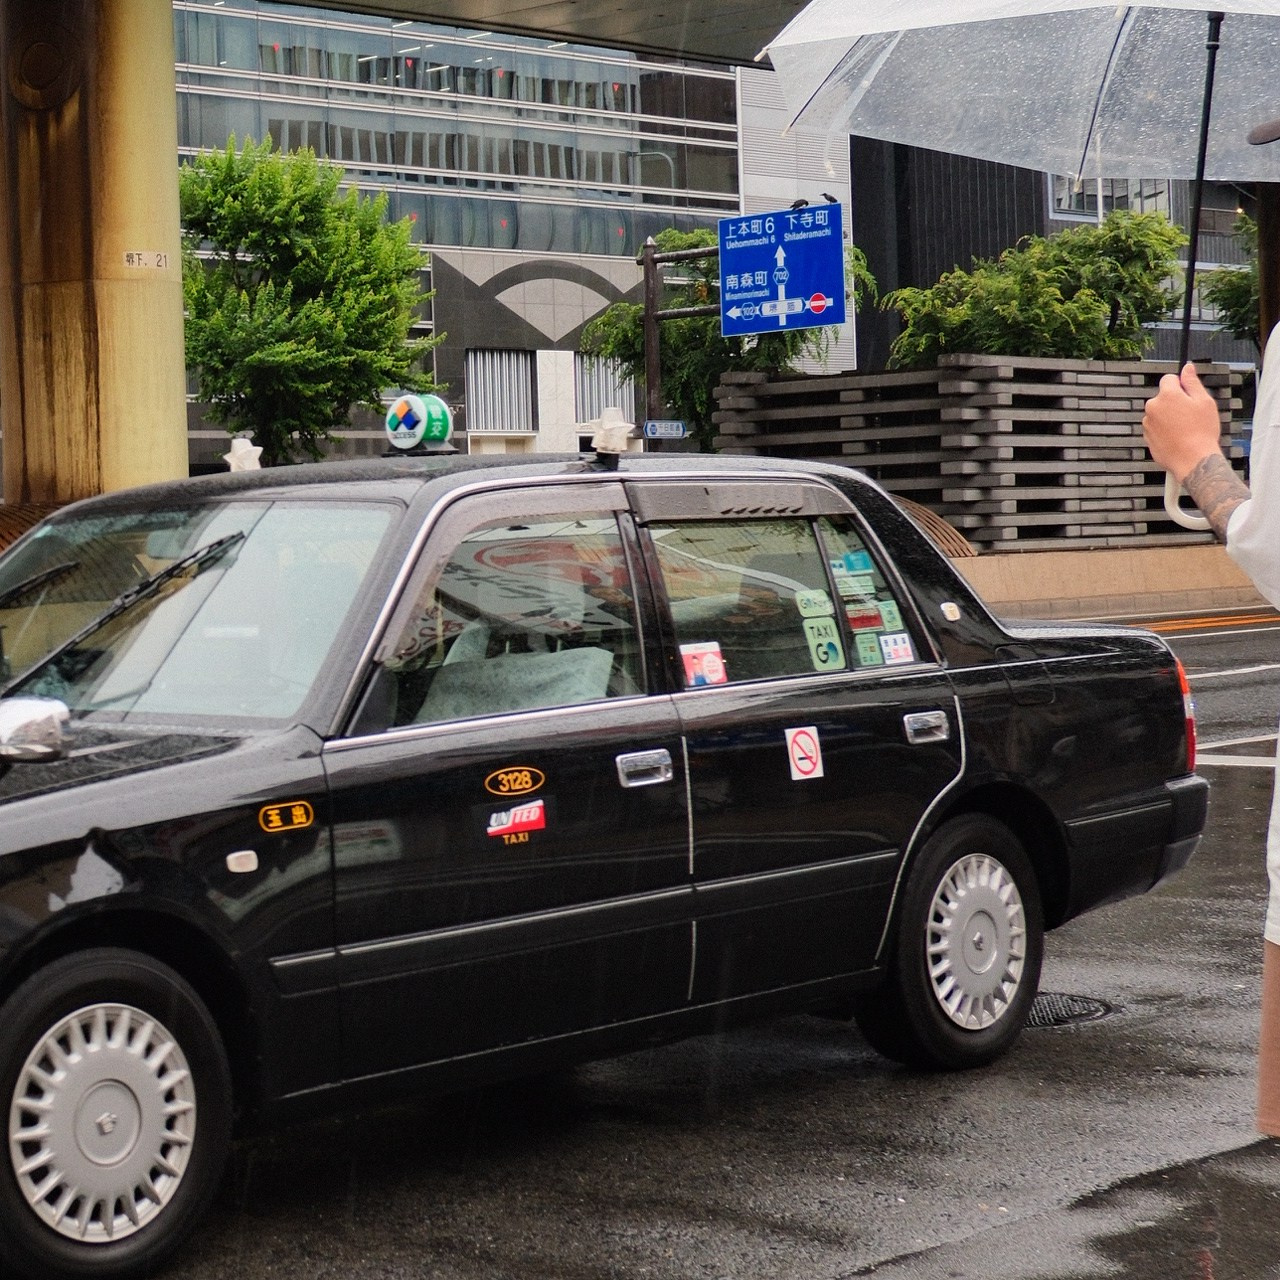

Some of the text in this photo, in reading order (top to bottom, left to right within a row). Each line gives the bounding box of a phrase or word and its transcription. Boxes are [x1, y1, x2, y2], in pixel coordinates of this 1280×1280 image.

[785, 210, 829, 230] 下寺町
[770, 235, 776, 243] 6
[784, 227, 831, 242] Shitaderamachi
[156, 253, 167, 268] 21
[725, 271, 768, 290] 南森町
[774, 271, 787, 281] 702
[809, 624, 835, 639] TAXI
[498, 770, 532, 791] 3128
[490, 807, 540, 827] UNITED
[503, 832, 529, 845] TAXI
